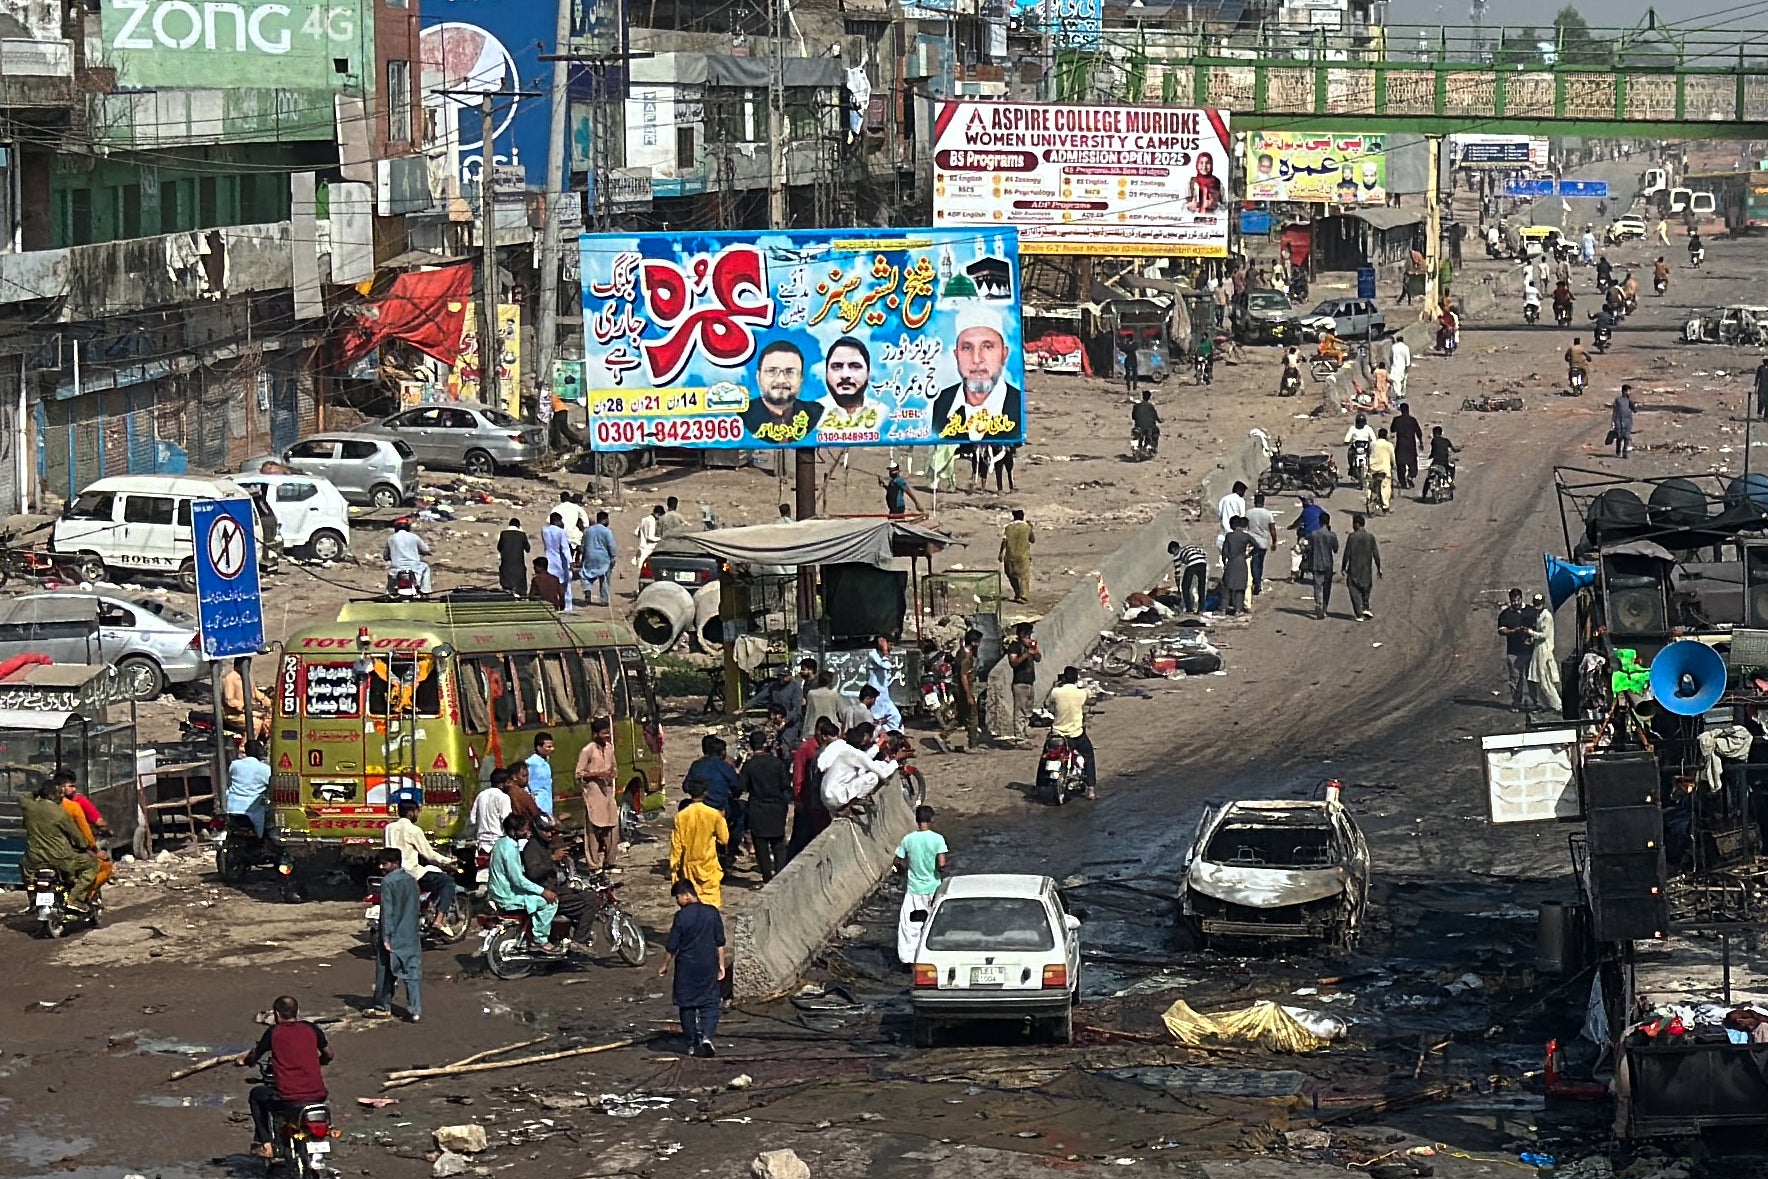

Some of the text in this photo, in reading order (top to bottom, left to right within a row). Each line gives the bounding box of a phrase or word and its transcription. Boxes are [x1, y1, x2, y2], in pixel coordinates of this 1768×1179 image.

[302, 3, 353, 41] 4G
[992, 107, 1050, 132] ASPIRE
[1054, 109, 1121, 134] COLLEGE
[1126, 111, 1200, 135] MURIDKE
[965, 132, 1200, 151] WOMEN UNIVERSITY CAMPUS
[950, 151, 1025, 171] BS Programs
[1050, 150, 1185, 166] ADMISSION OPEN 2025
[594, 302, 646, 345] جاری
[604, 346, 641, 385] ہے
[606, 397, 624, 412] 28
[644, 395, 660, 410] 21
[681, 391, 698, 408] 14
